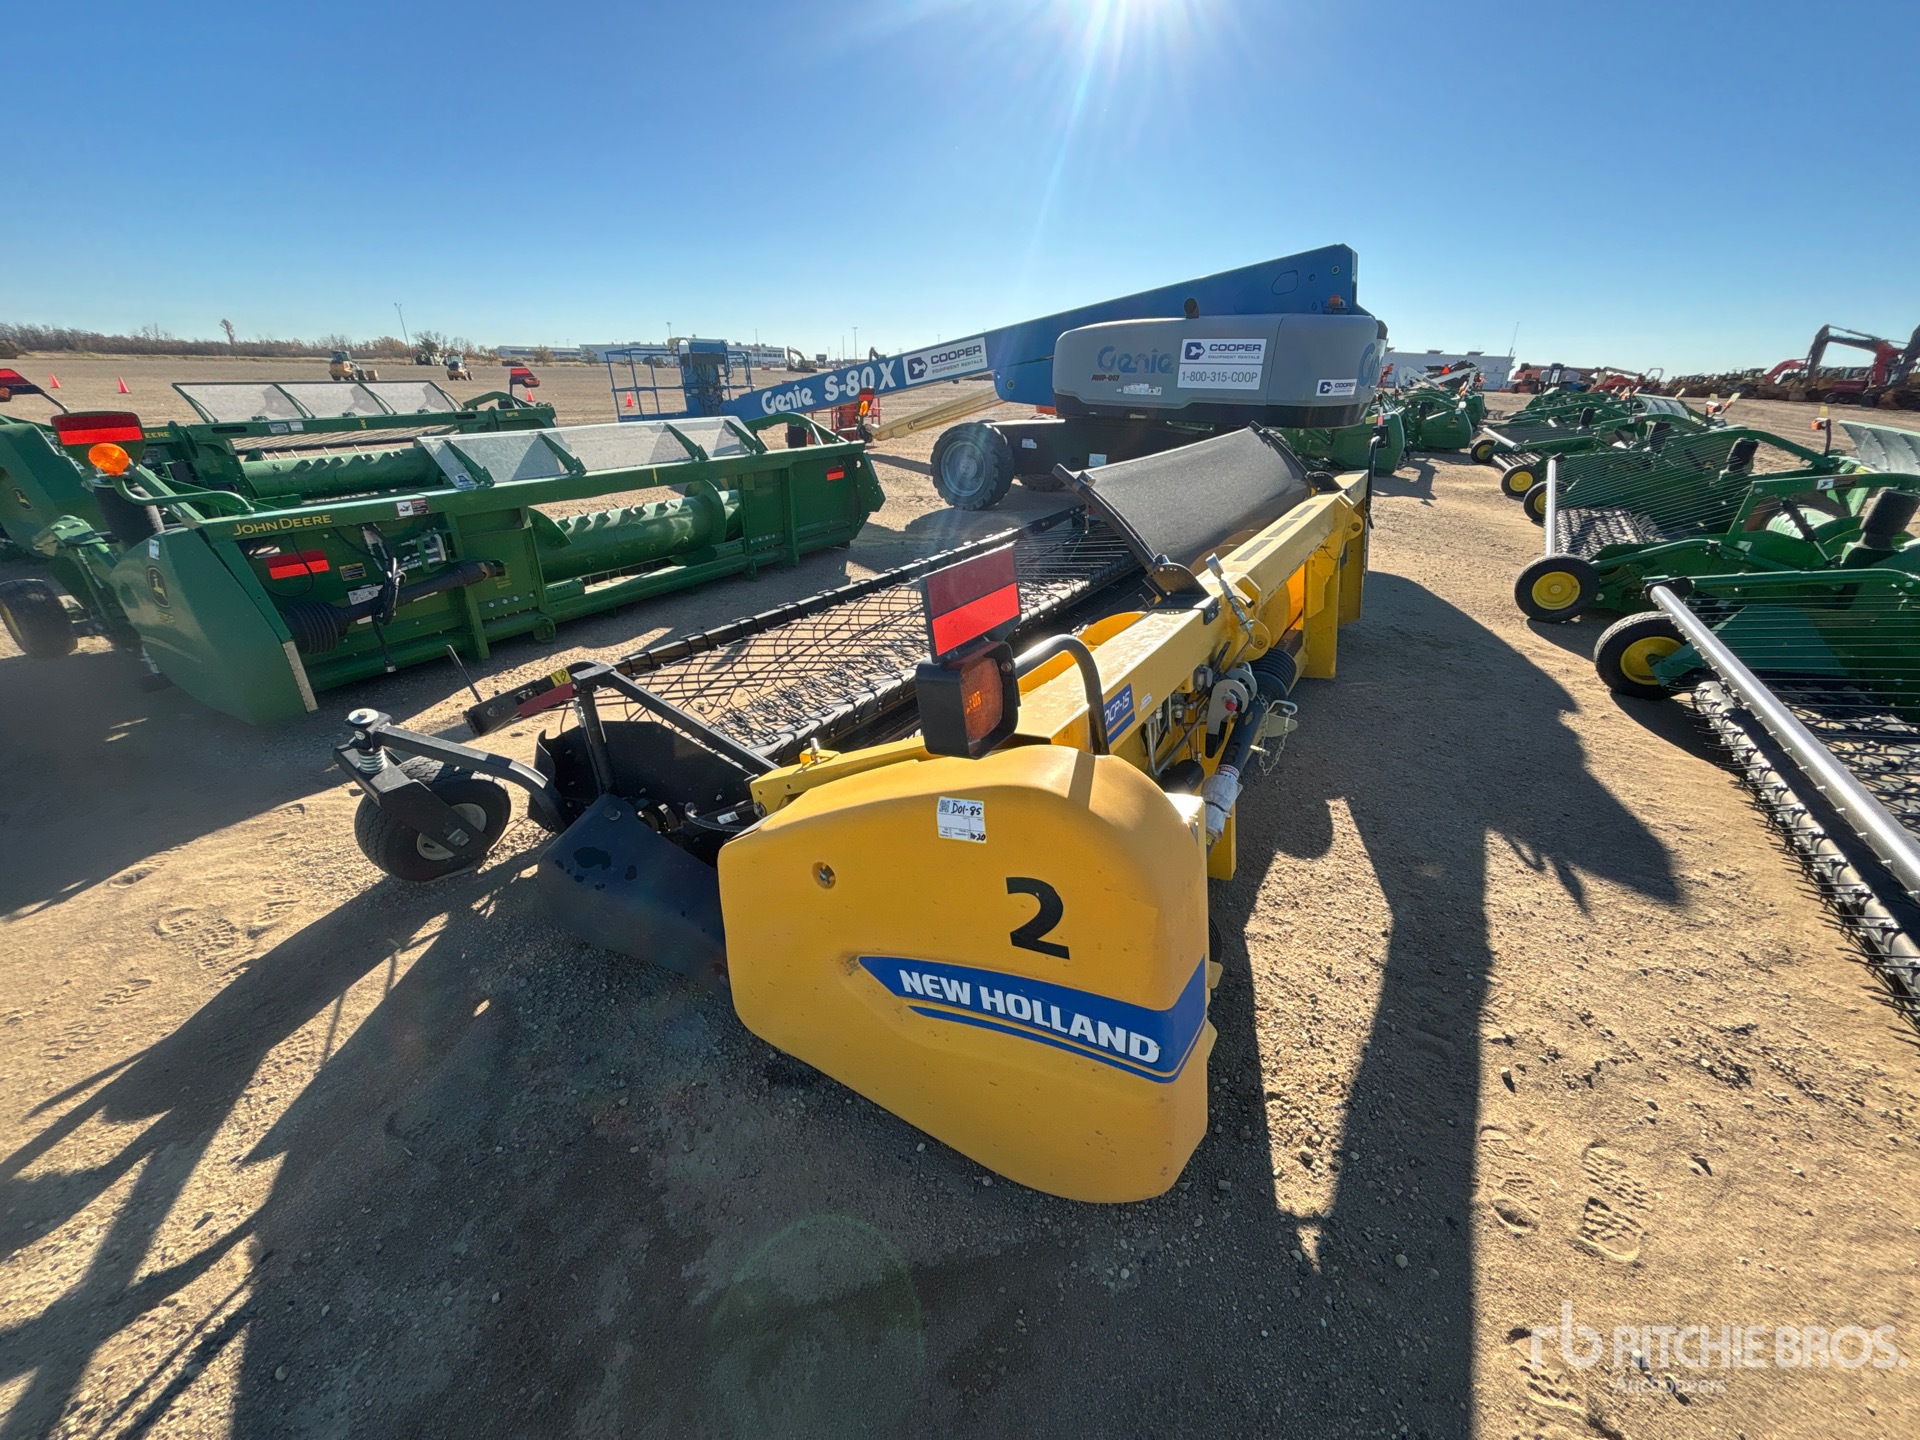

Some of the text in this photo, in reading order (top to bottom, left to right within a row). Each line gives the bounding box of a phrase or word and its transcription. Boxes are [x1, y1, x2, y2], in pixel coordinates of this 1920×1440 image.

[931, 345, 982, 364] COOPER
[1209, 343, 1262, 352] COOPER
[932, 358, 984, 374] EQUIPMENT RENTALS
[1097, 345, 1174, 374] Genie
[1181, 371, 1258, 383] 1-800-315-COOP
[761, 385, 816, 415] Genie
[233, 515, 332, 536] JOHN DEERE
[1006, 877, 1070, 960] 2
[899, 969, 1161, 1064] NEW HOLLAND
